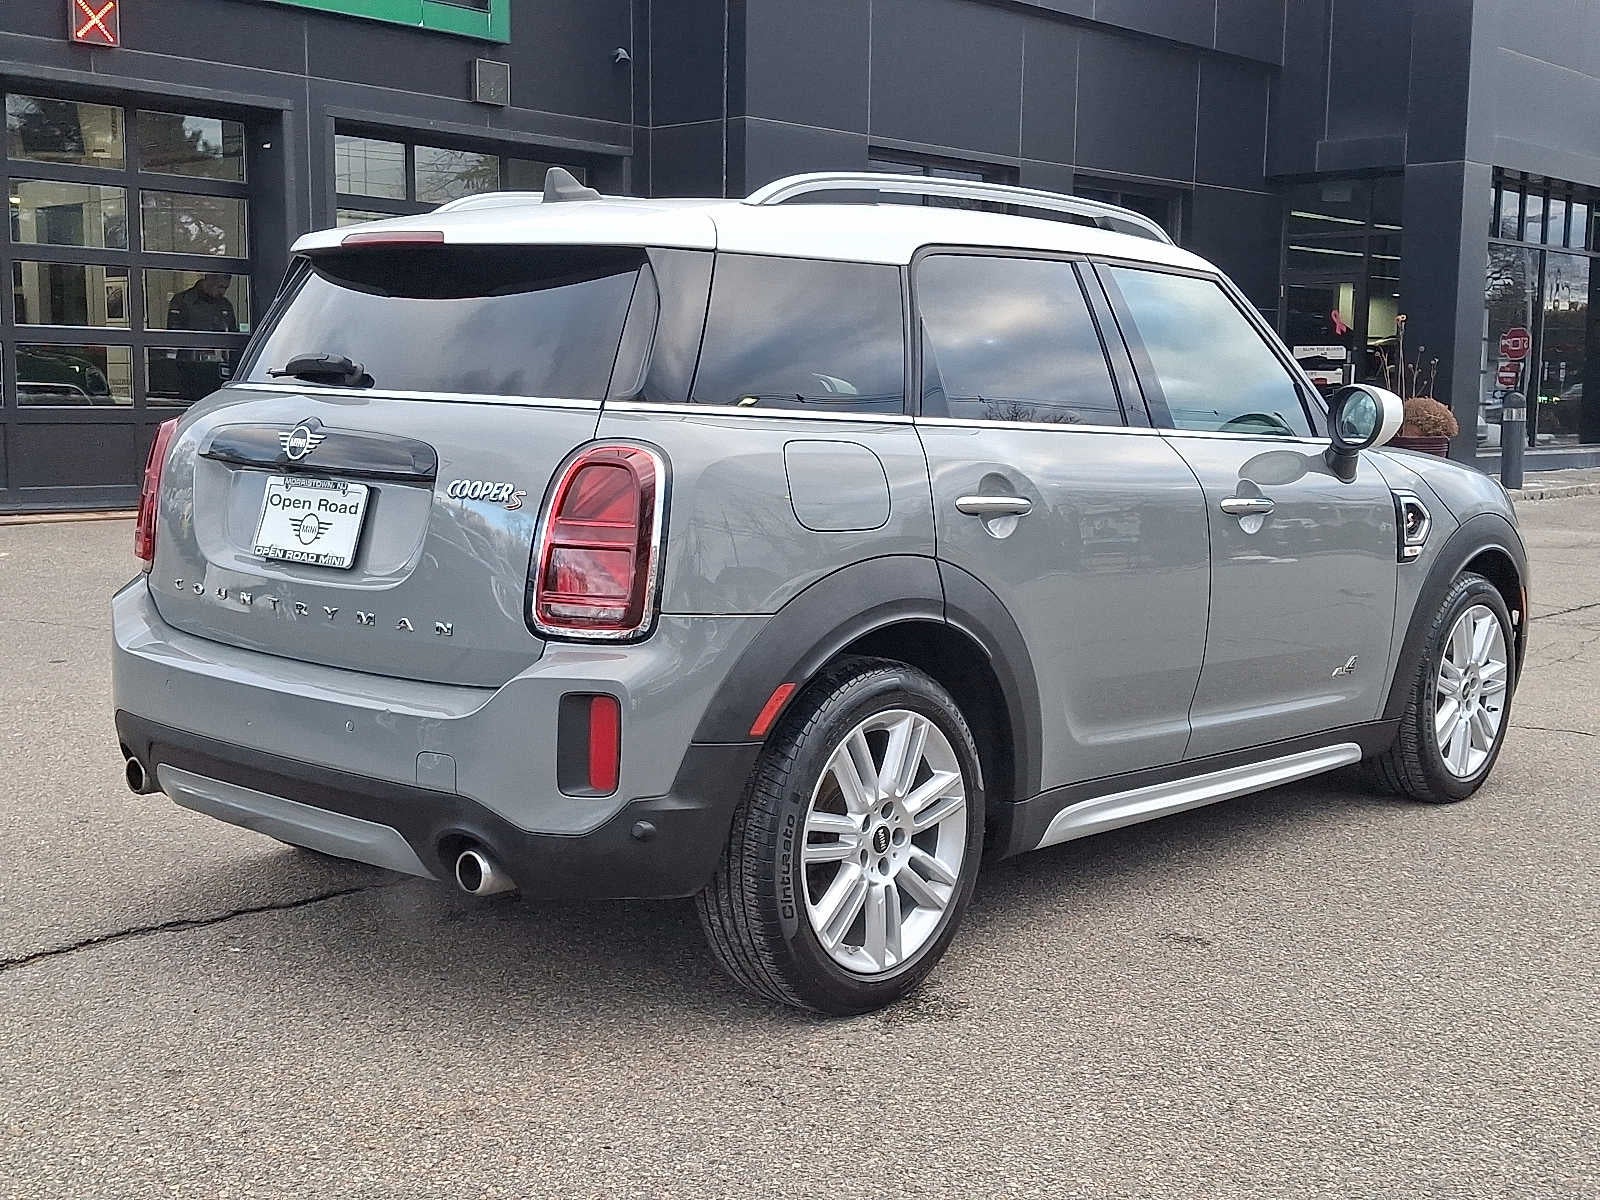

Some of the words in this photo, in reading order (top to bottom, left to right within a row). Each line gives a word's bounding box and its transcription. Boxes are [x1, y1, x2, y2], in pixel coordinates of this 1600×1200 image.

[447, 479, 515, 504] COOPER
[270, 493, 312, 511] Open
[317, 498, 360, 515] Road
[302, 525, 318, 534] MINI
[254, 545, 284, 559] OPEN
[285, 550, 317, 563] ROAD
[318, 553, 345, 567] MINI
[174, 578, 454, 637] COUNTRYMAN
[877, 828, 888, 851] MINI
[777, 813, 797, 921] Cinturato
